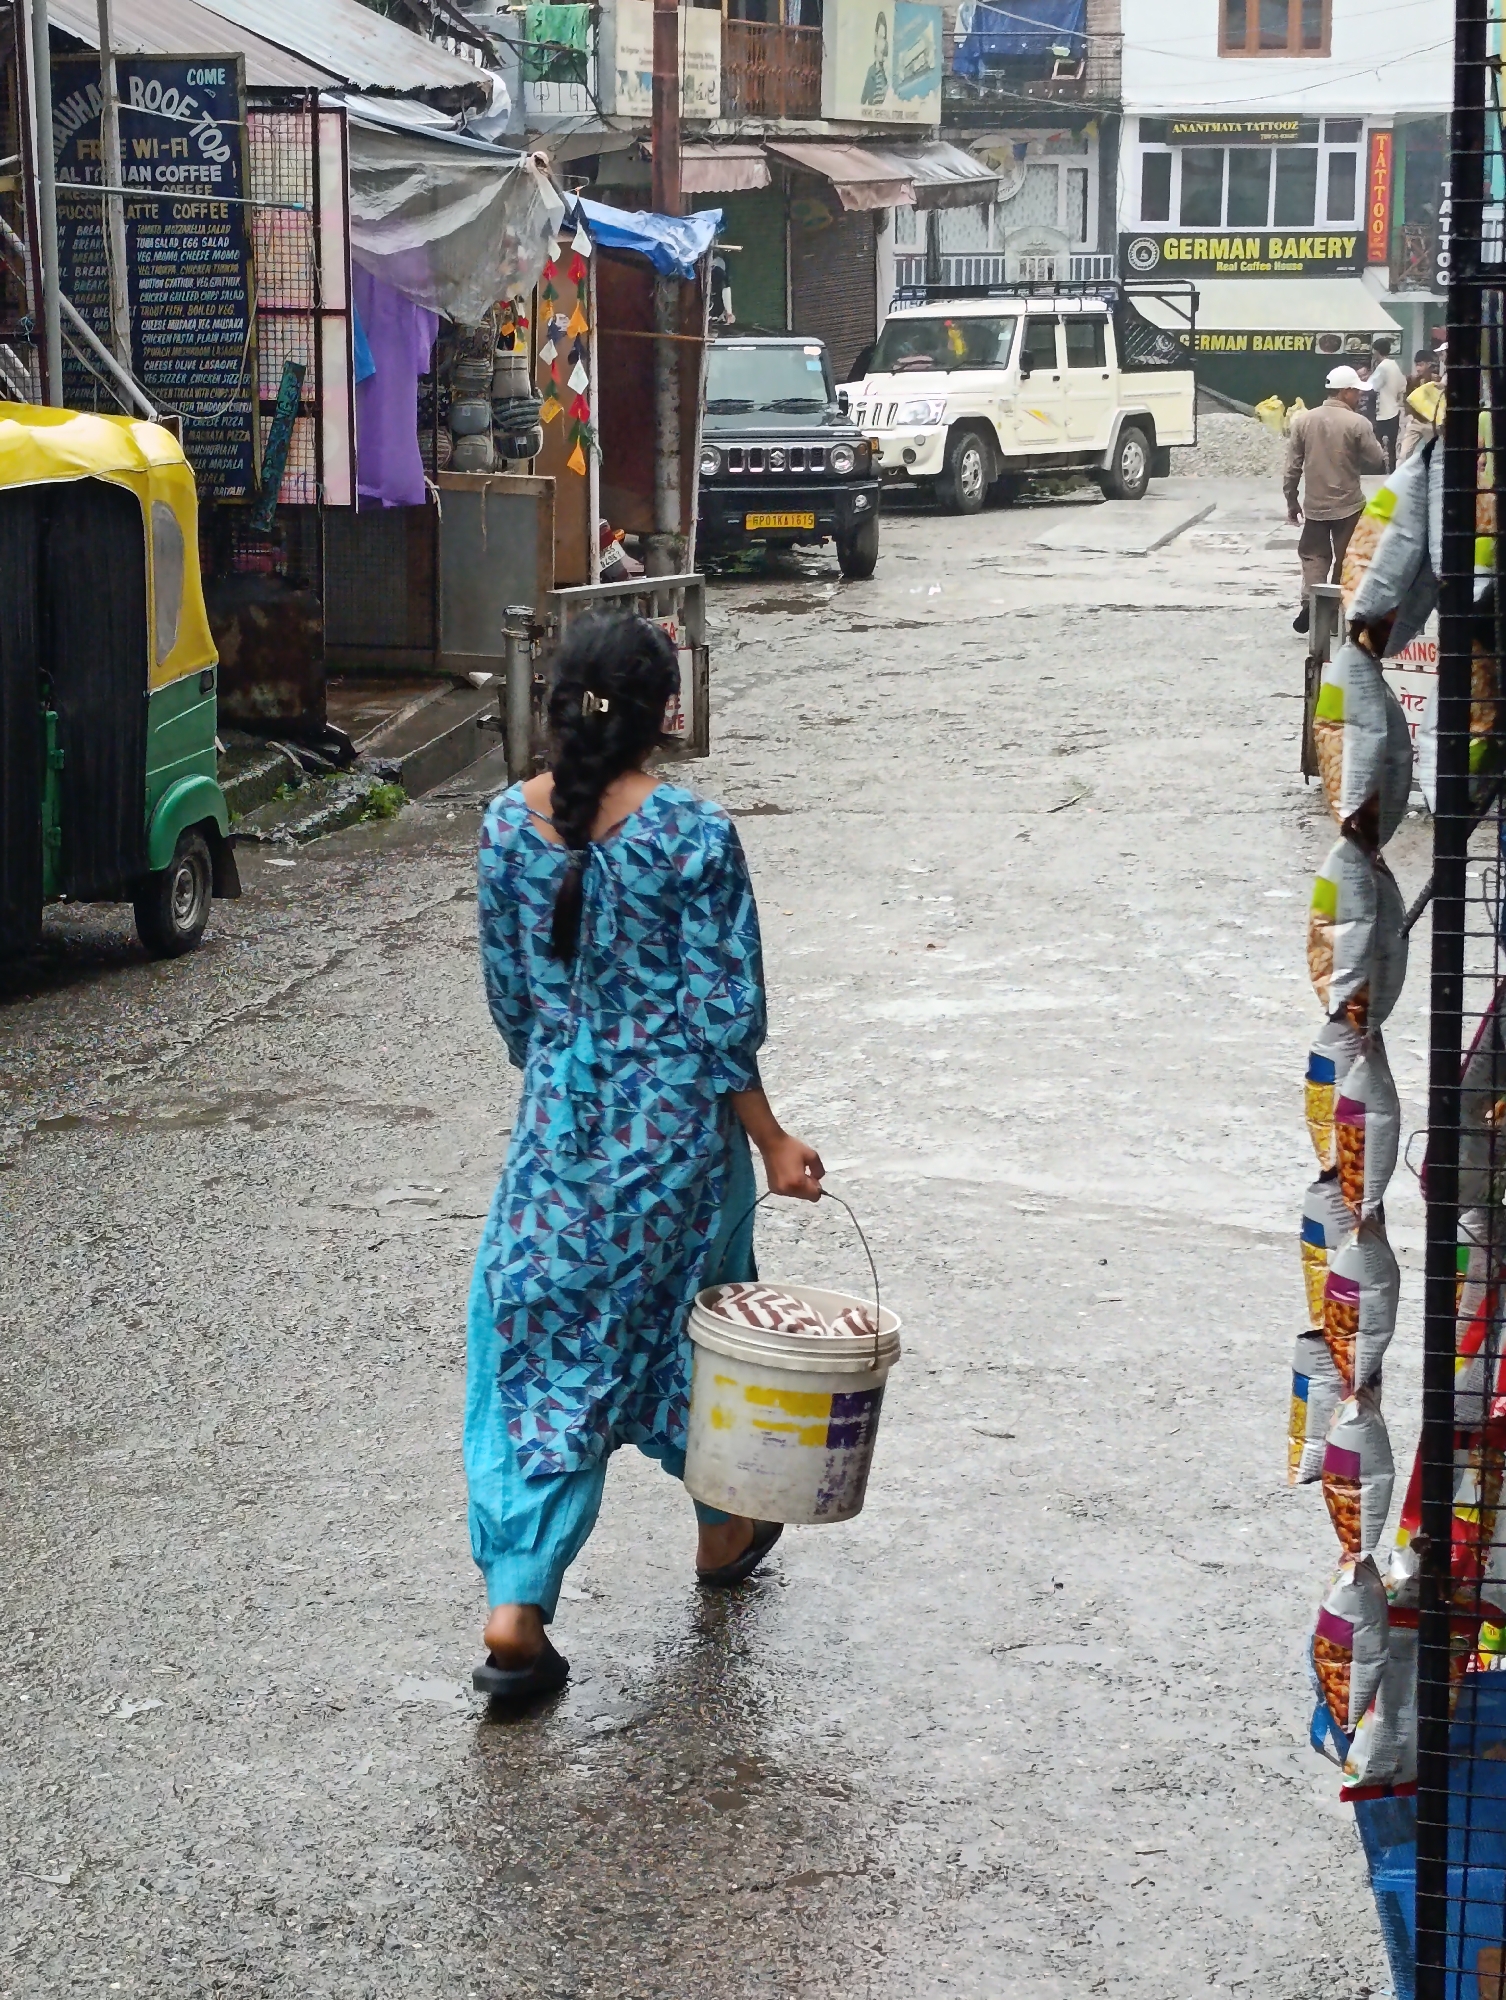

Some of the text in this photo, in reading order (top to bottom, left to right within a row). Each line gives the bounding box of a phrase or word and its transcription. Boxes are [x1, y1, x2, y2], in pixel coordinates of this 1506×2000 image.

[187, 68, 226, 85] COME
[129, 76, 198, 119] ROOF
[189, 110, 231, 163] TOP
[77, 137, 189, 160] FRE WI-FI
[156, 165, 223, 182] COFFEE
[173, 203, 229, 219] COFFEE
[182, 237, 199, 249] EGG
[201, 237, 230, 248] SALAD
[1164, 237, 1260, 259] GERMAN
[1269, 237, 1357, 259] BAKERY
[180, 250, 210, 261] CHEESE
[1217, 262, 1237, 271] Real
[1253, 334, 1315, 351] BAKERY
